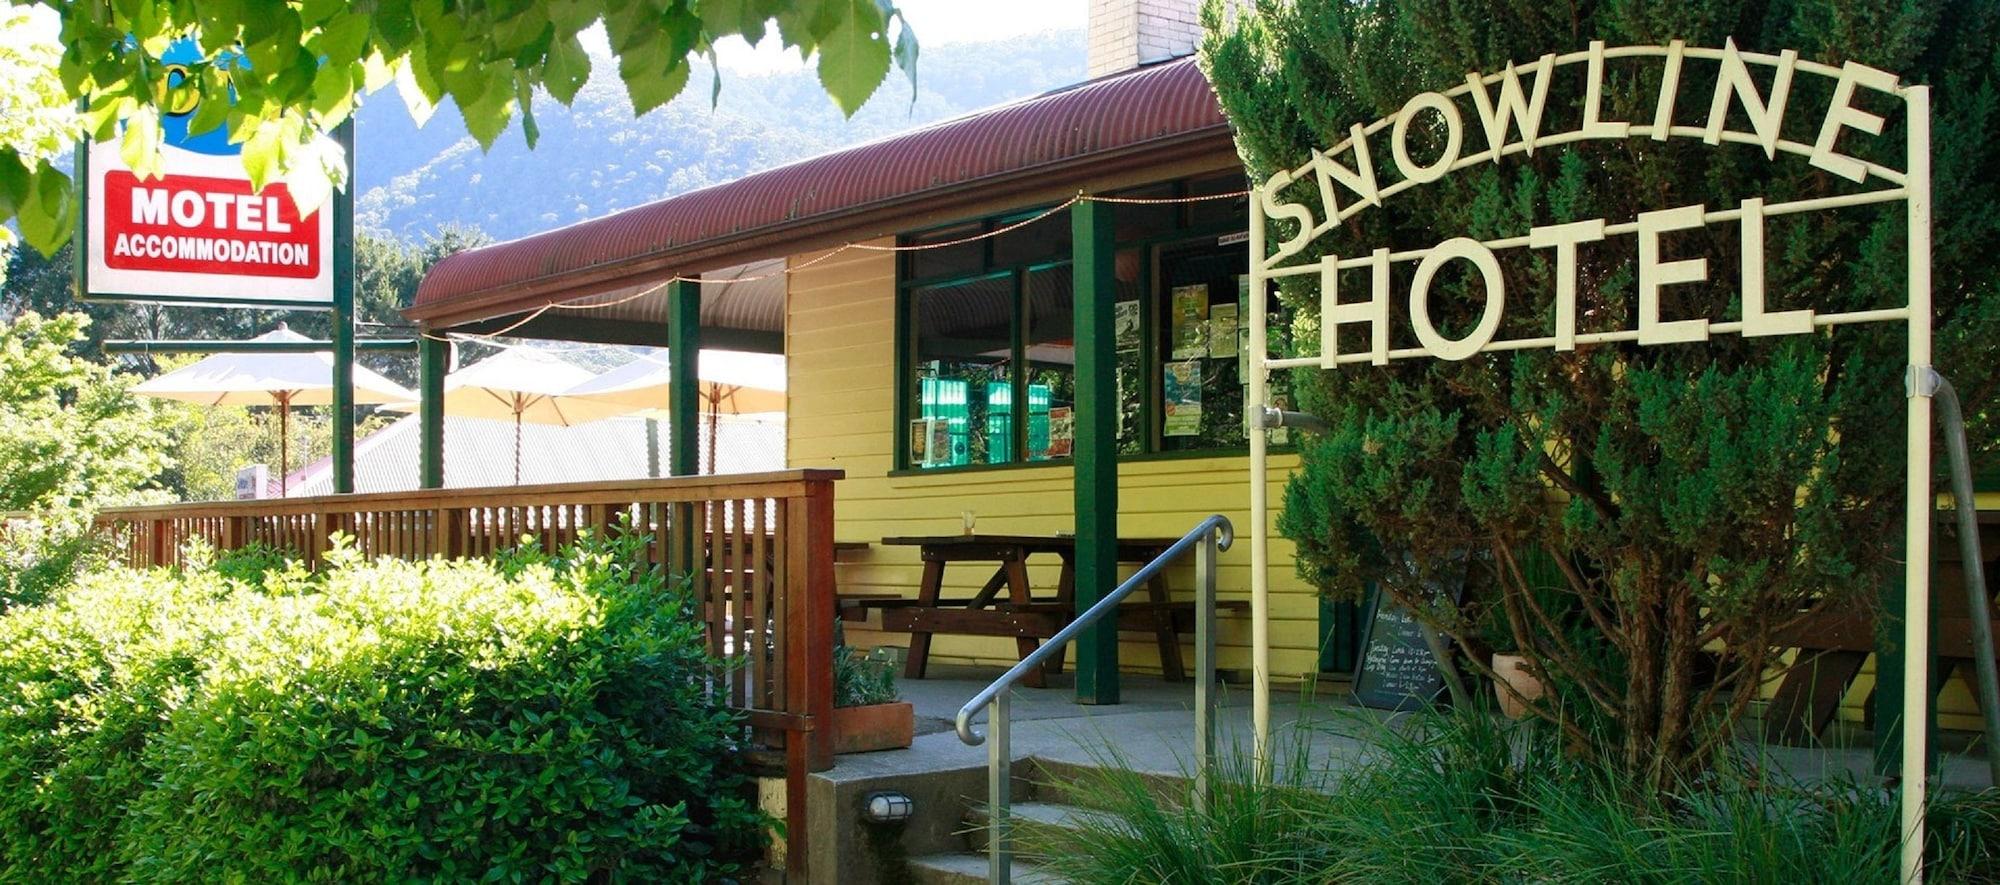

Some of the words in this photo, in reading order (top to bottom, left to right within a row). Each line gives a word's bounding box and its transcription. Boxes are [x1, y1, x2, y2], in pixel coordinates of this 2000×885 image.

[1261, 36, 1899, 254] SNOWLINE
[113, 233, 309, 266] ACCOMMODATION
[131, 187, 291, 233] MOTEL
[1321, 198, 1814, 369] HOTEL
